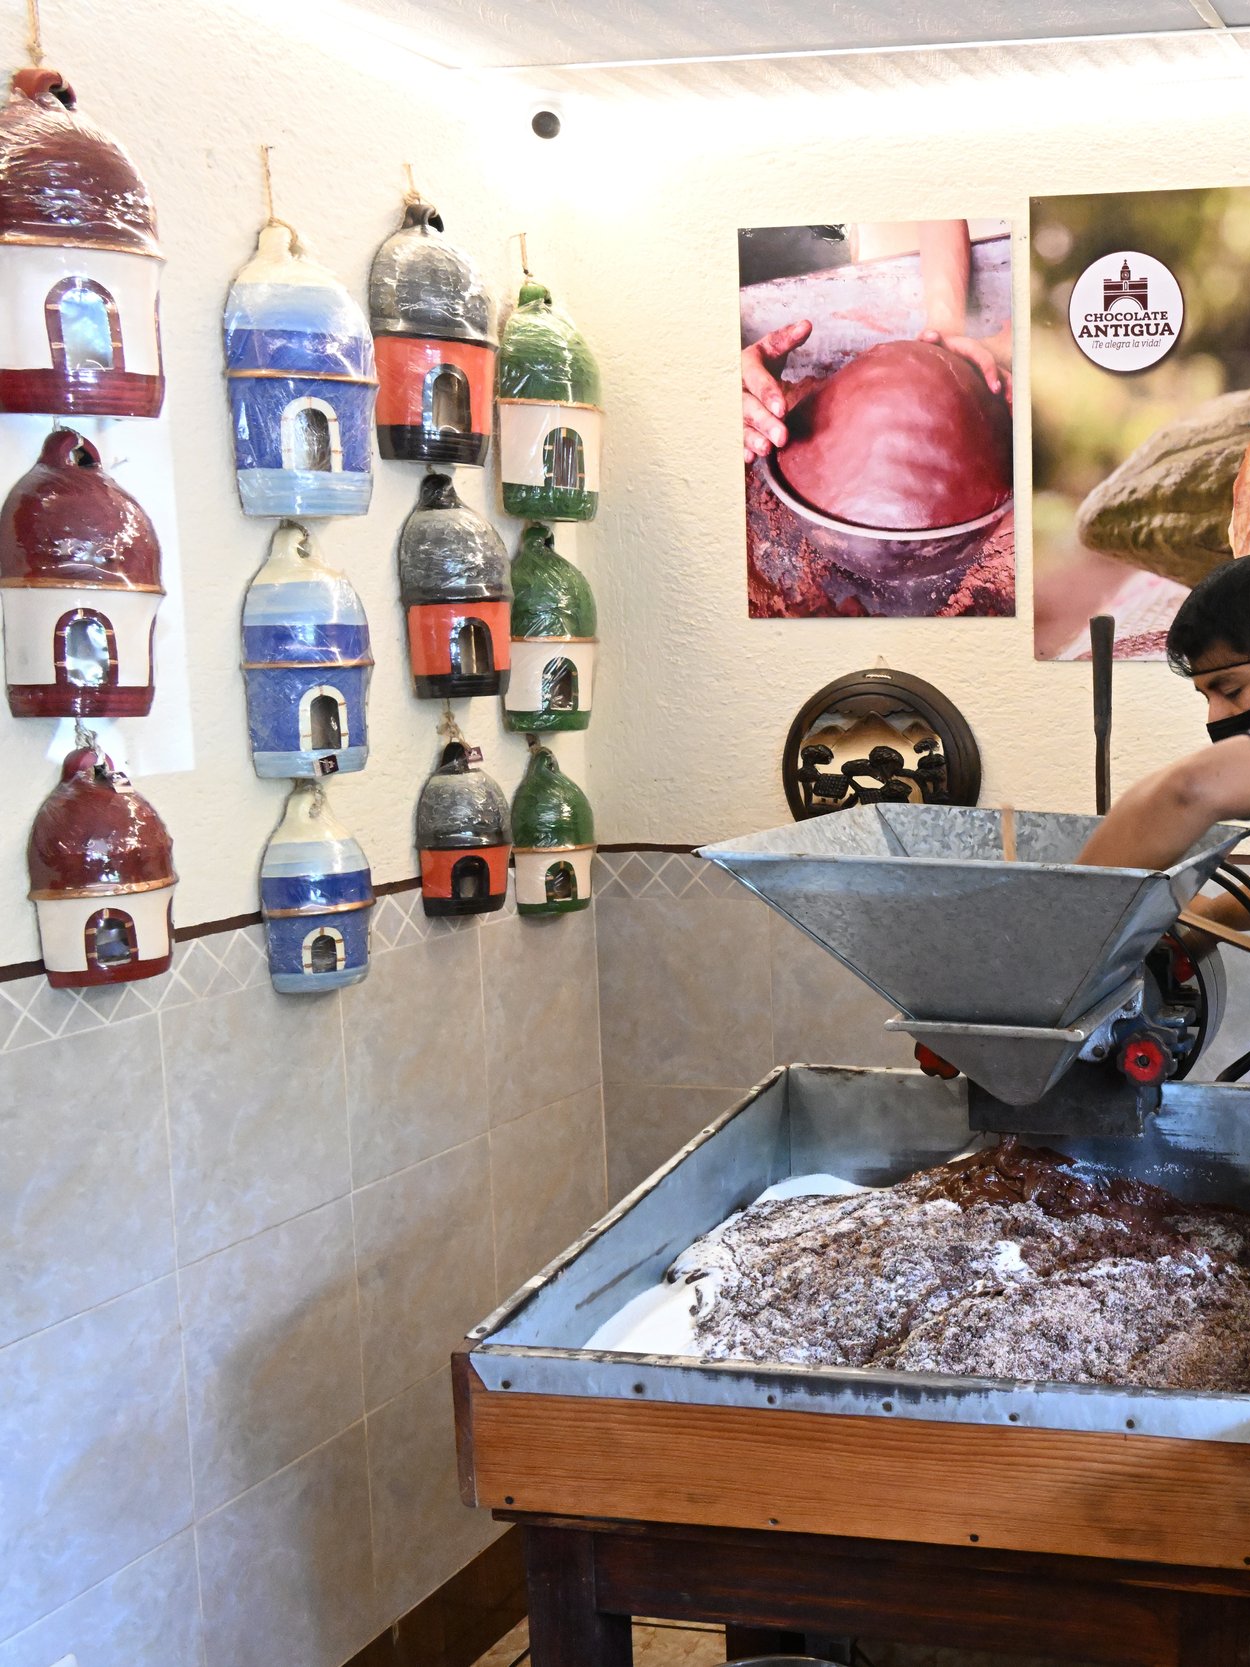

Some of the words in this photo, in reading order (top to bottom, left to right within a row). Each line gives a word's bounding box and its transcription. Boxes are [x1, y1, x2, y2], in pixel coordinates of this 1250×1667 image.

[1084, 311, 1168, 322] CHOCOLATE
[1078, 322, 1174, 338] ANTIGUA
[1105, 339, 1130, 350] alegra
[1132, 339, 1140, 348] la
[1142, 338, 1161, 347] vida!
